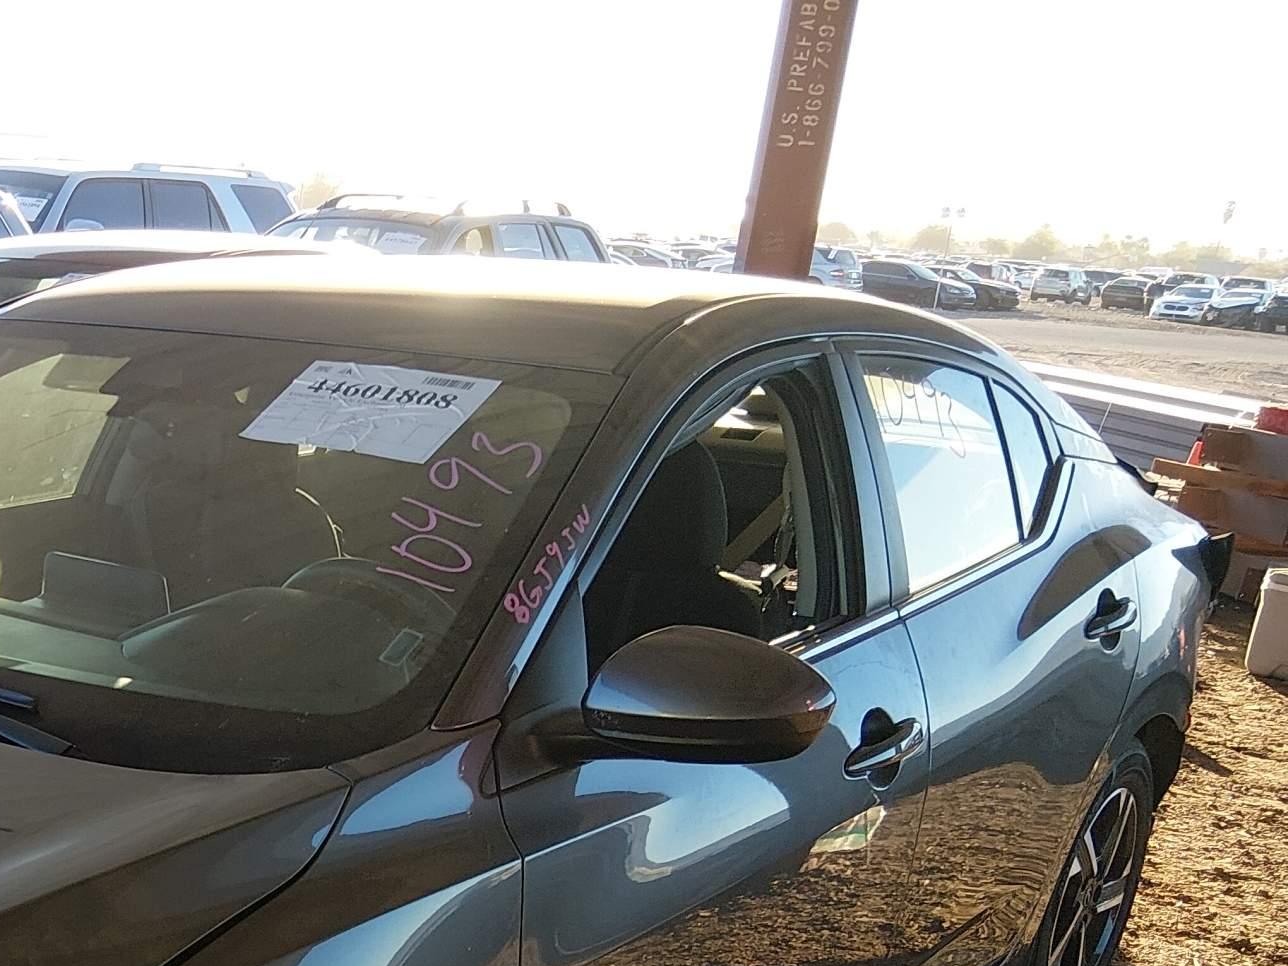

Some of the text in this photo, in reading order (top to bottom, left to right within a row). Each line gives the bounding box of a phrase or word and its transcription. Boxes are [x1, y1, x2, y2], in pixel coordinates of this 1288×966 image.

[776, 106, 802, 148] U.S.
[307, 378, 459, 410] 44601808
[376, 431, 544, 594] 10493
